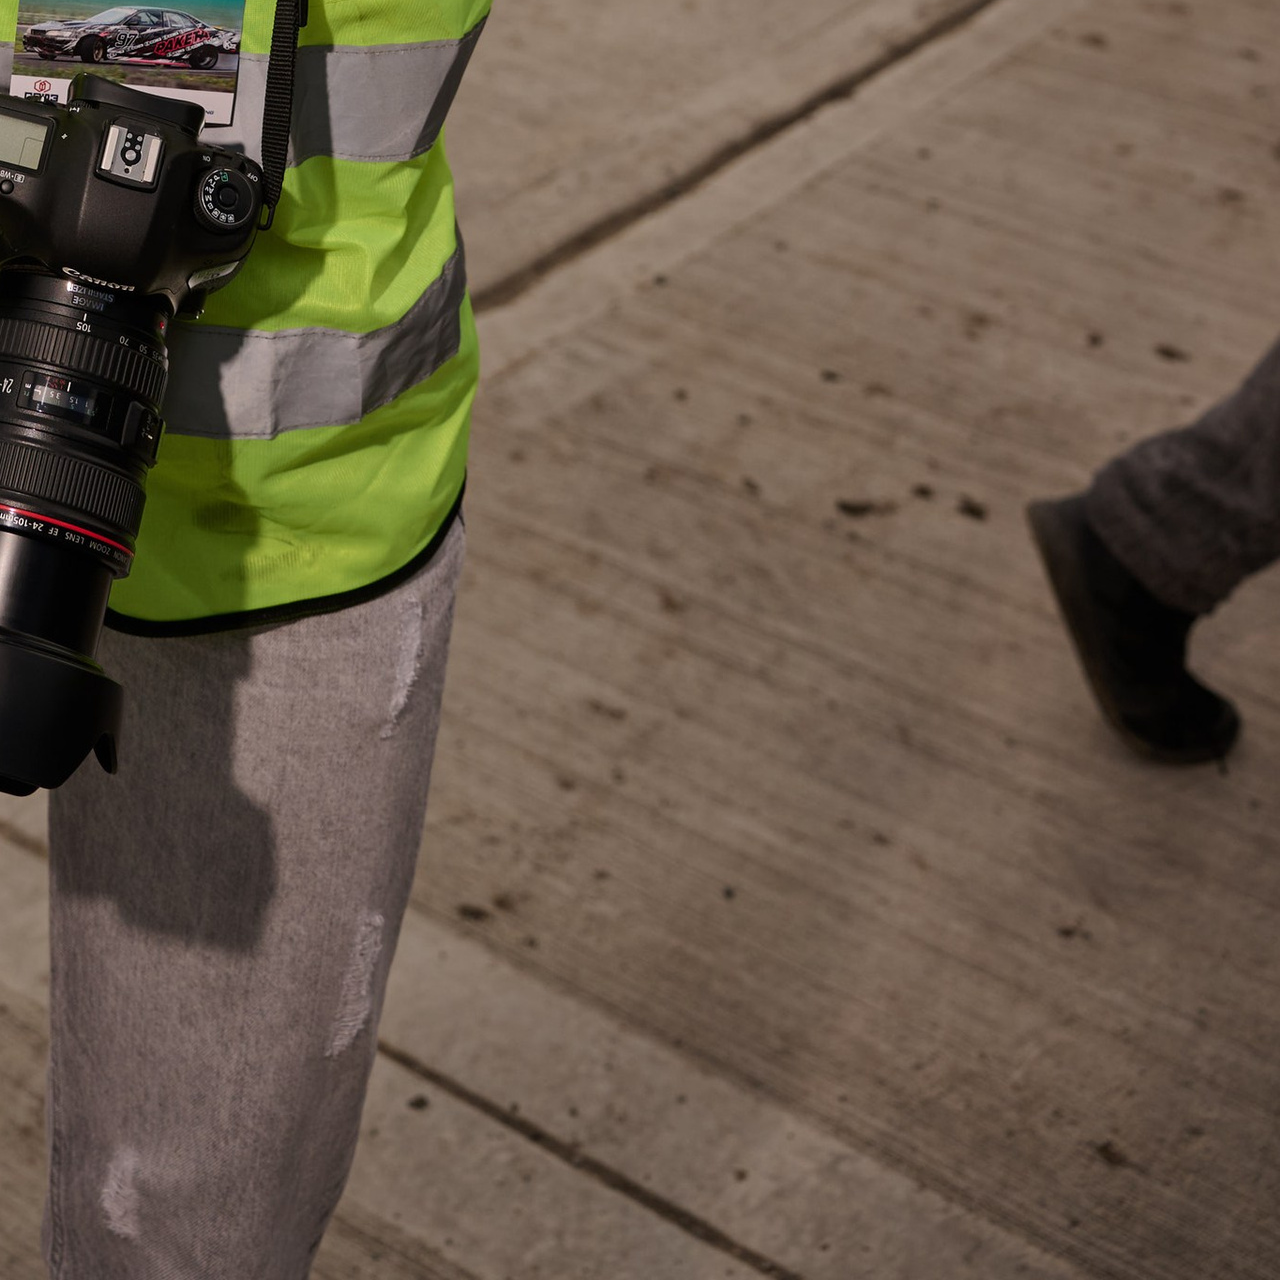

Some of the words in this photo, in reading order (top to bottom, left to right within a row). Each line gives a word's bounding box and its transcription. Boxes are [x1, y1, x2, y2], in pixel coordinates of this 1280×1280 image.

[115, 31, 140, 49] 97
[246, 172, 259, 182] OFF
[61, 266, 135, 292] Canon
[72, 295, 104, 311] IMAGE
[76, 321, 91, 333] 105
[119, 335, 130, 347] 70
[48, 527, 59, 536] EF
[64, 531, 85, 545] LENS
[89, 540, 111, 555] ZOOM
